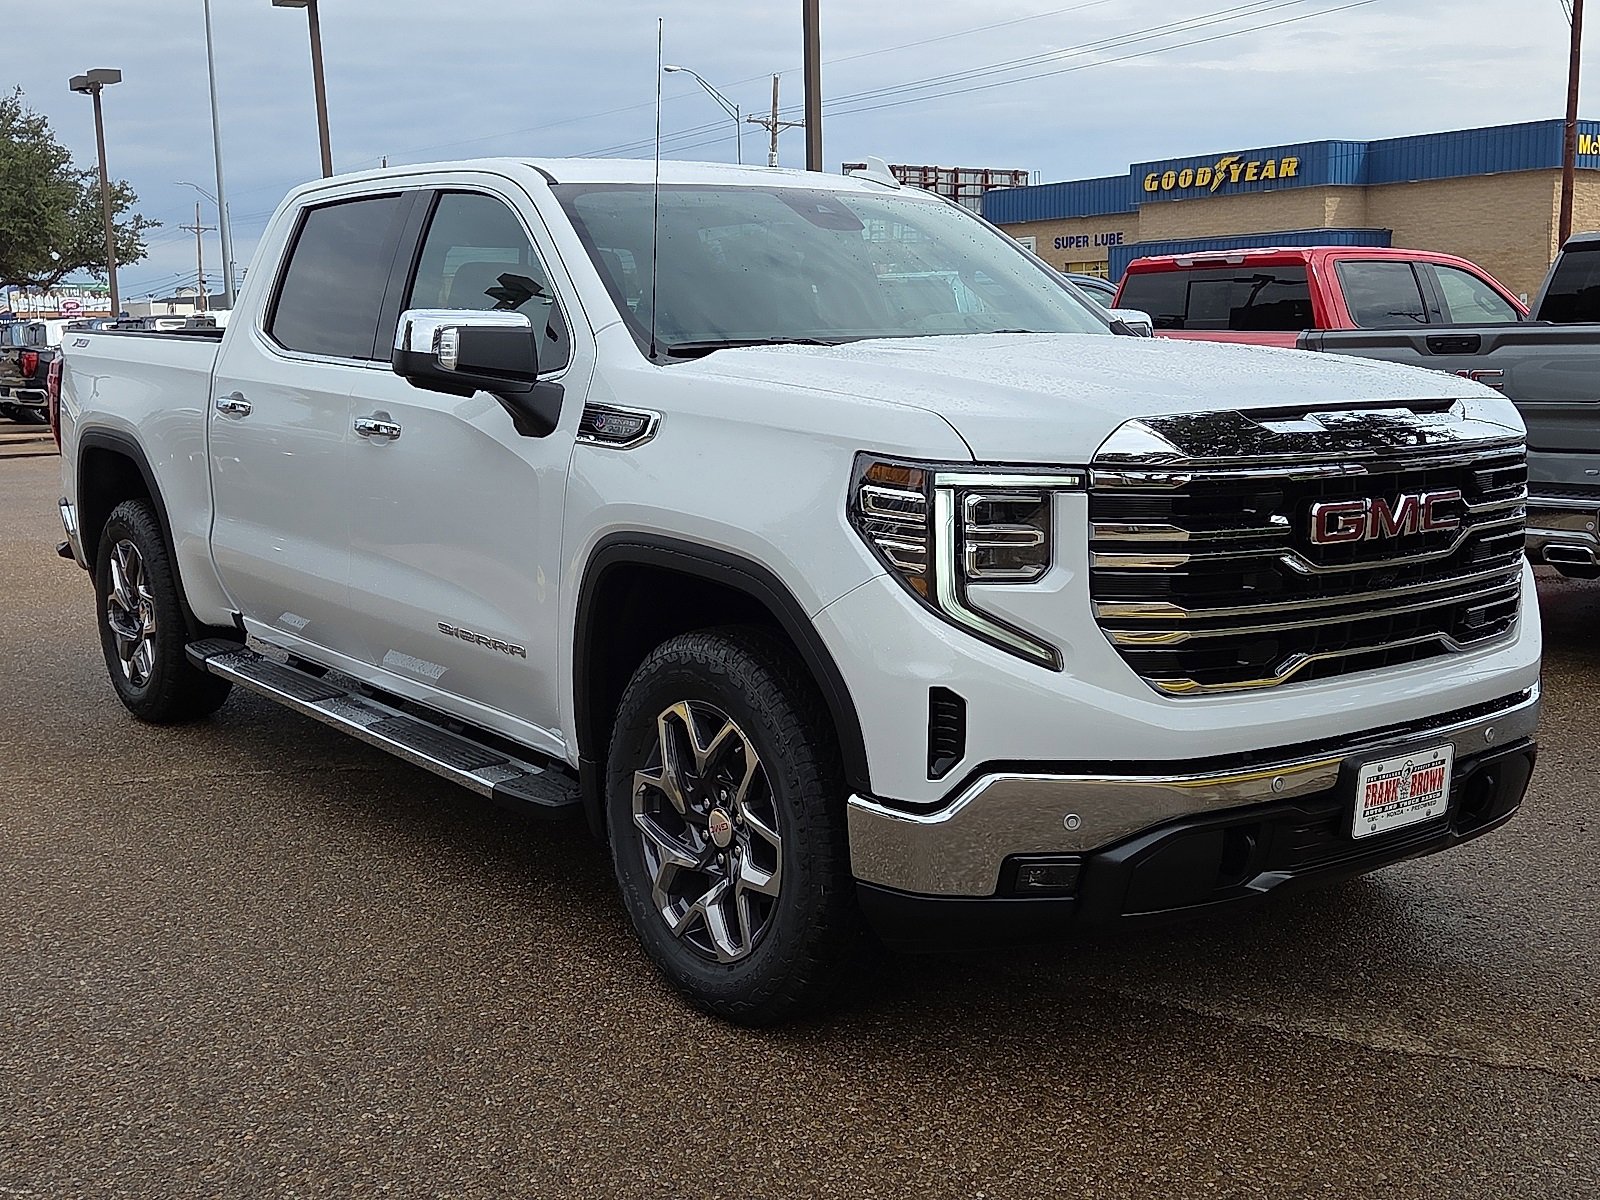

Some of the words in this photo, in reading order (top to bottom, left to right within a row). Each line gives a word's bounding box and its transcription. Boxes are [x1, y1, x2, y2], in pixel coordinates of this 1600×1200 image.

[1578, 134, 1600, 155] Mc
[1143, 156, 1299, 192] GOODYEAR
[1054, 235, 1089, 250] SUPER
[1094, 232, 1124, 247] LUBE
[1311, 490, 1461, 545] GMC
[437, 621, 527, 659] SIERRA
[1364, 778, 1400, 808] FRANK
[1409, 766, 1445, 798] BROWN
